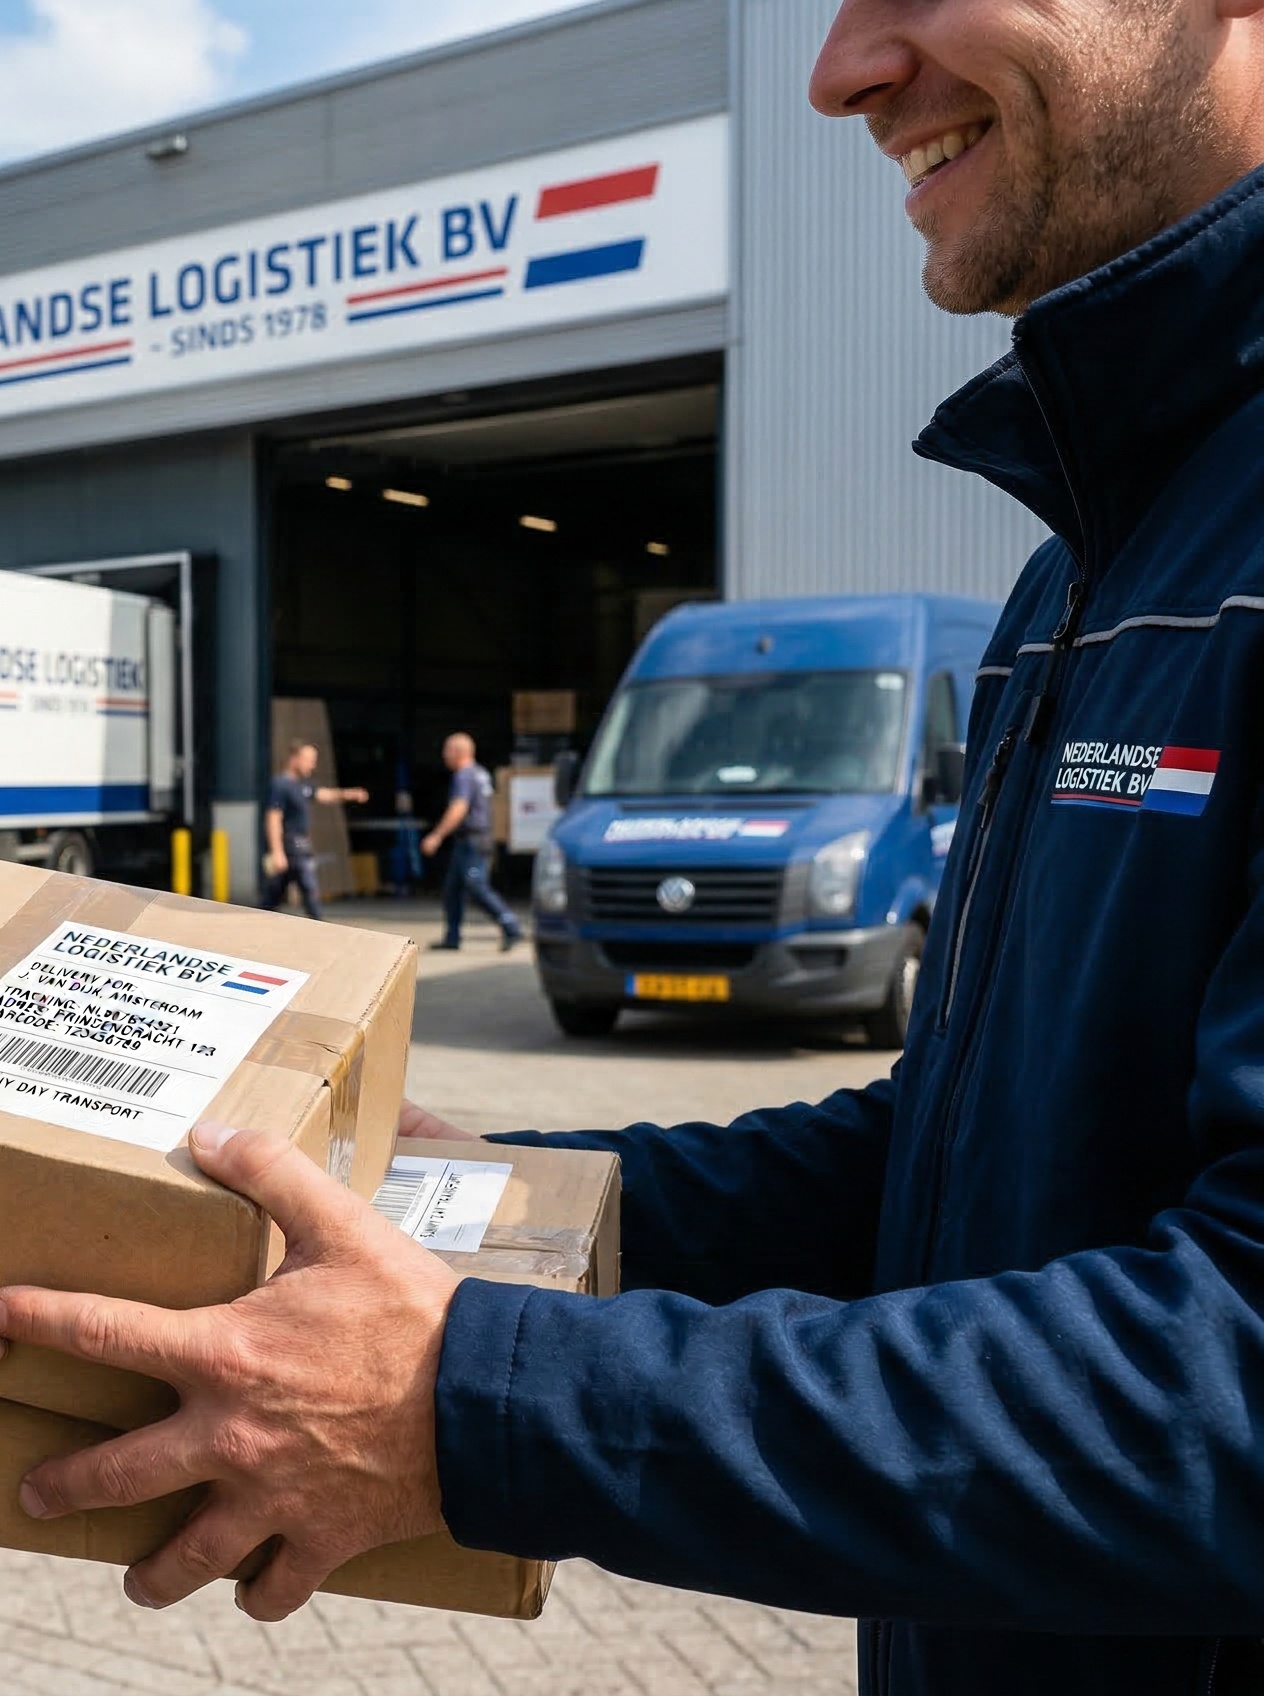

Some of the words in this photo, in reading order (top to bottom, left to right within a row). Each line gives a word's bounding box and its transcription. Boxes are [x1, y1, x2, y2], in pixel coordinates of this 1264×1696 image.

[148, 214, 420, 319] LOGISTIEK
[440, 193, 520, 262] BV
[171, 313, 254, 358] SINDS
[264, 301, 328, 338] 1978
[1061, 742, 1162, 768] NEDERLANDSE
[1055, 768, 1126, 792] LOGISTIEK
[1127, 774, 1151, 795] BV
[63, 931, 234, 976] NEDERLANDSE
[38, 974, 68, 988] VAN
[176, 968, 213, 984] BV
[15, 1081, 49, 1097] DAY
[52, 1090, 144, 1121] TRANSPORT
